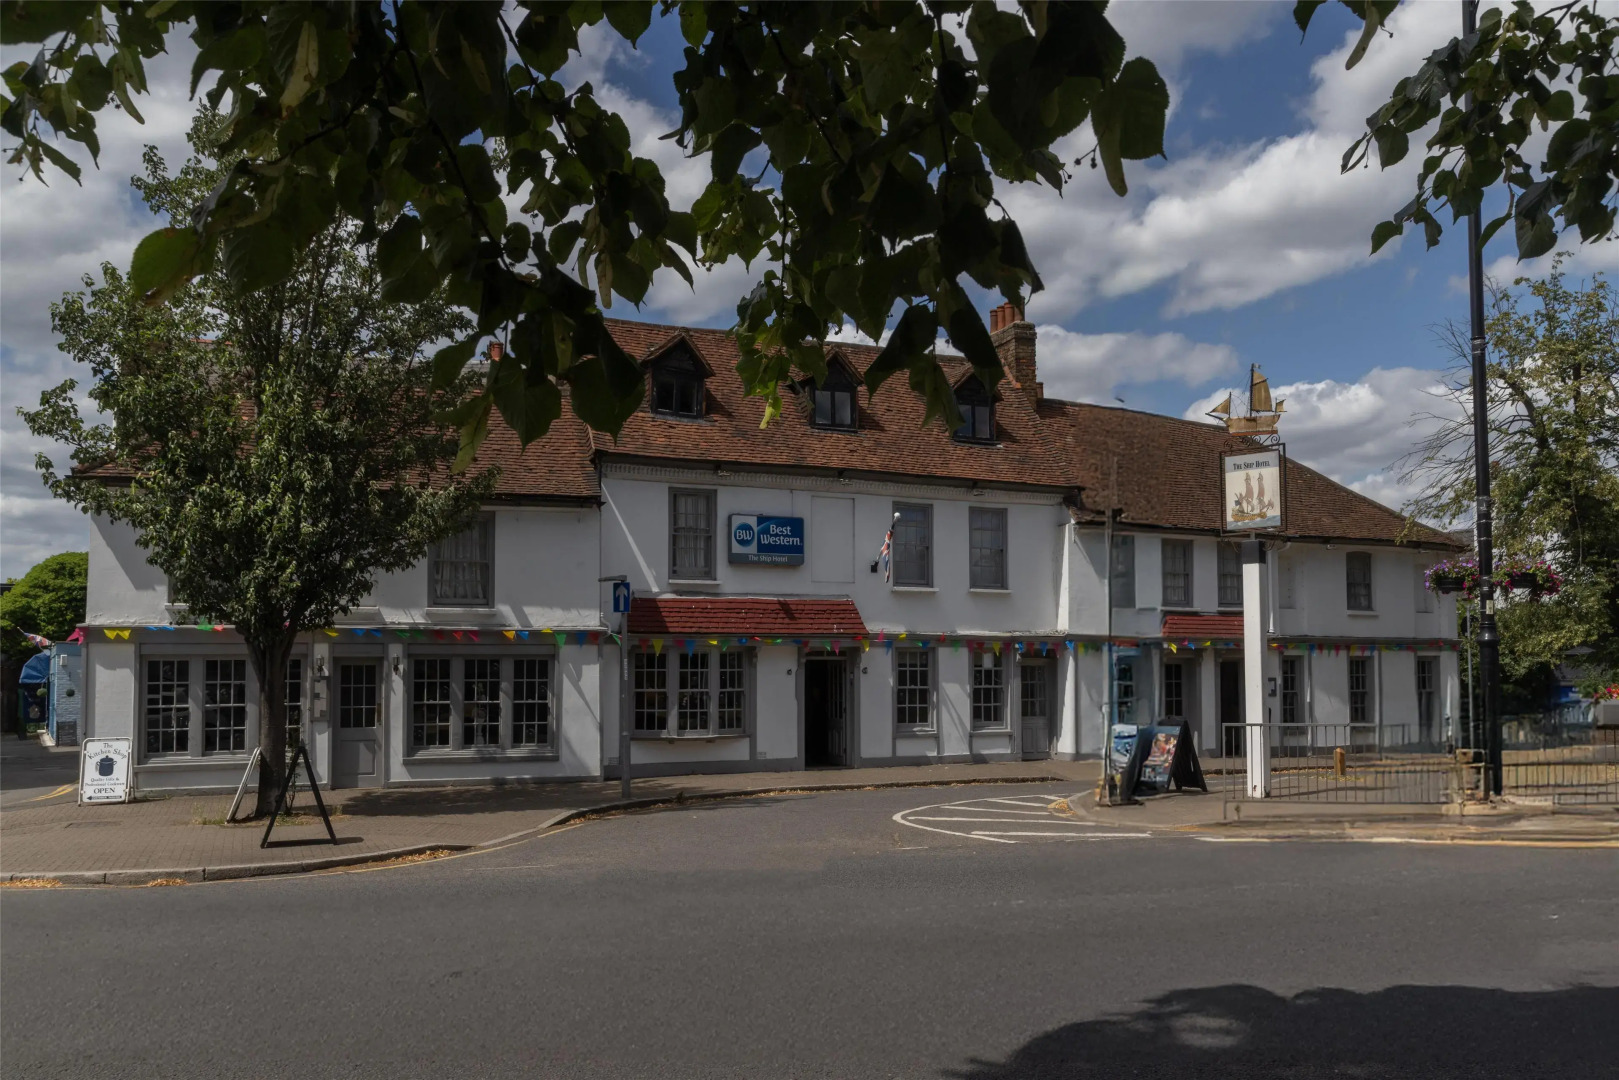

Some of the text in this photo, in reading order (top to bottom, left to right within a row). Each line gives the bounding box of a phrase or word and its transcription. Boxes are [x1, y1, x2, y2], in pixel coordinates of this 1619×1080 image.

[737, 530, 753, 540] BW
[770, 525, 791, 535] Best
[761, 535, 800, 545] Western
[88, 749, 127, 759] Kitchen Shop
